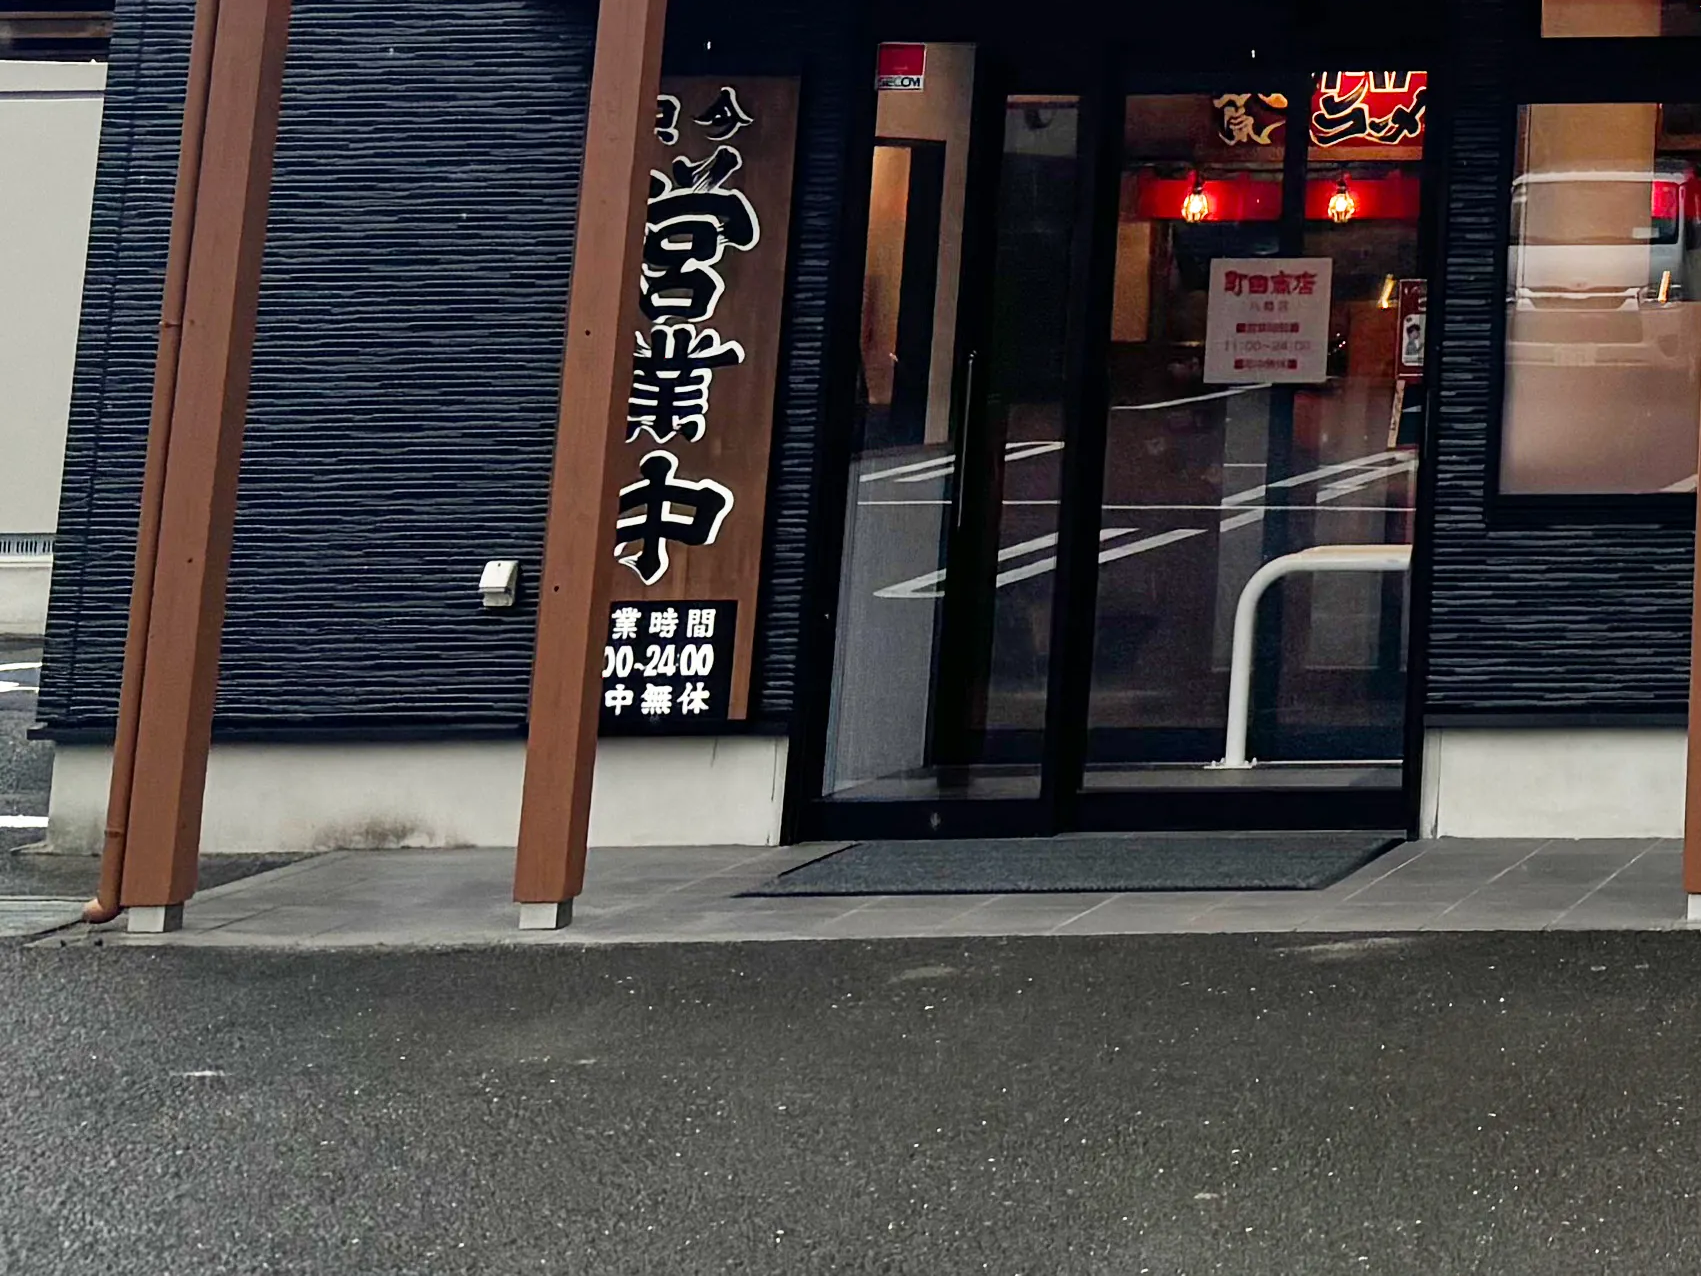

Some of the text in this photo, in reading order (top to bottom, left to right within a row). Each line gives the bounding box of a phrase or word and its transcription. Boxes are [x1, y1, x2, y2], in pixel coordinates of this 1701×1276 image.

[614, 144, 760, 586] 営業中
[604, 682, 710, 716] 中無休
